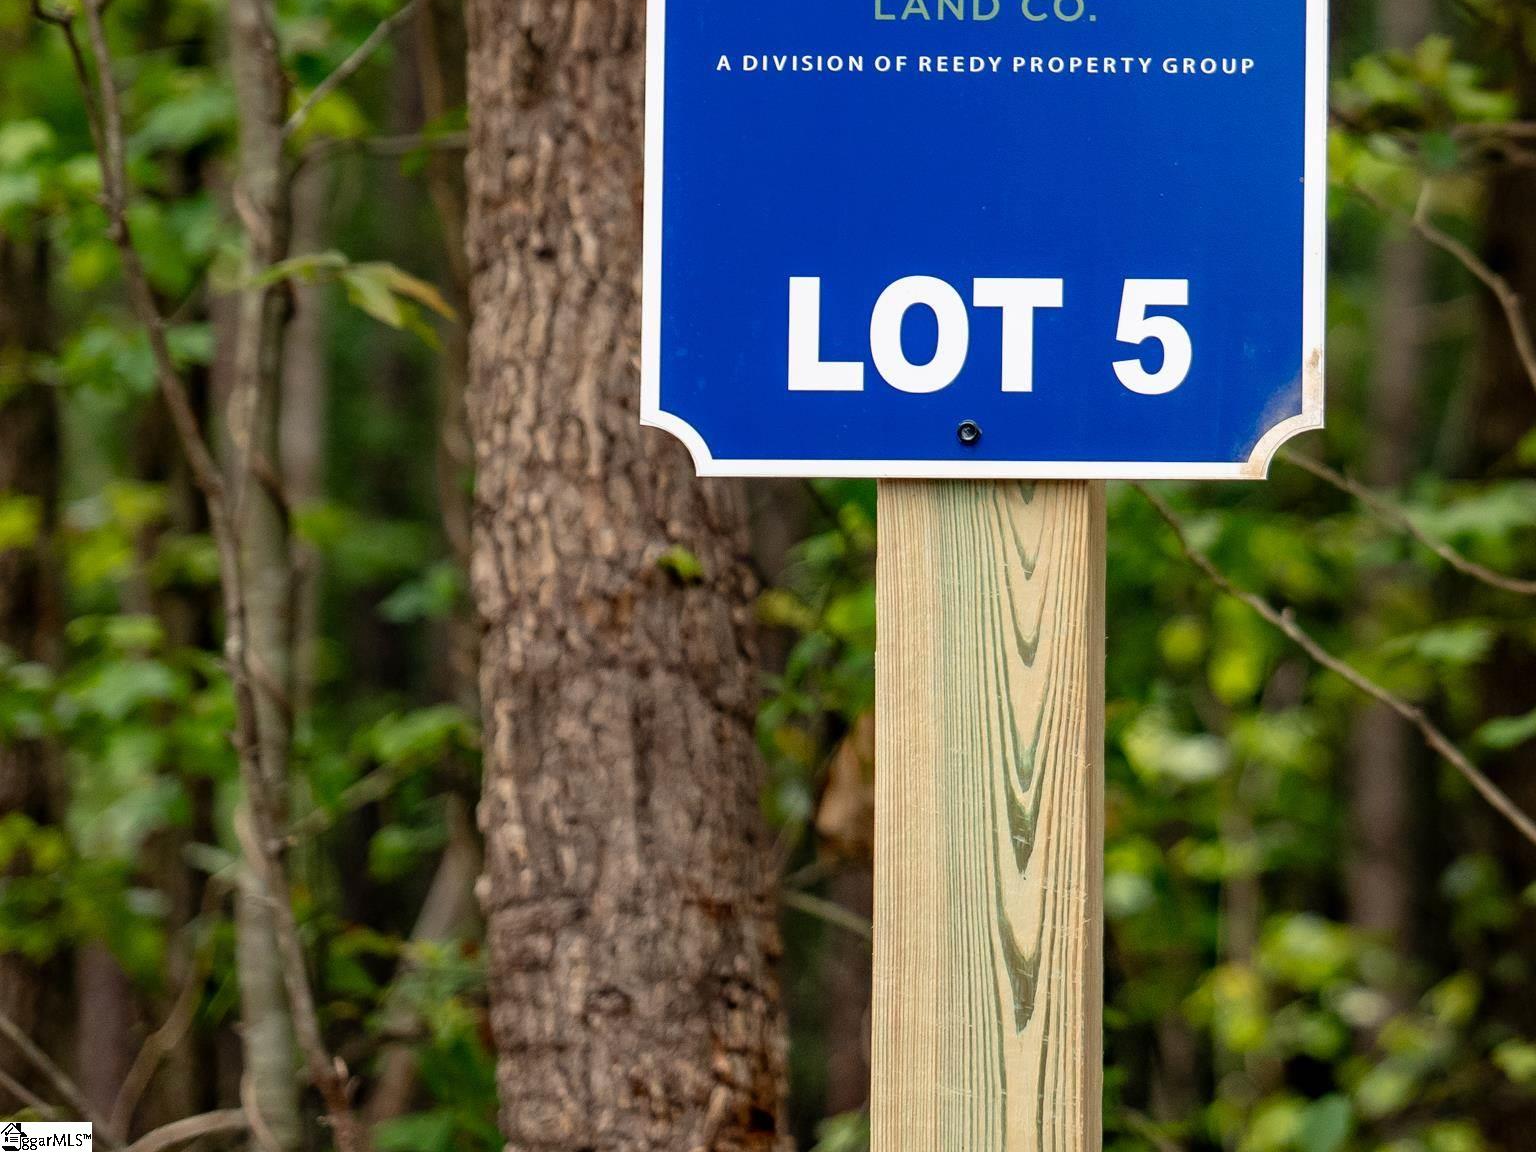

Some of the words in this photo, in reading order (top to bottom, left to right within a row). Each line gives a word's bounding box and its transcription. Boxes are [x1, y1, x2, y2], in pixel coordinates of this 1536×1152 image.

[716, 54, 732, 71] A
[742, 54, 863, 72] DIVISION
[874, 55, 908, 72] OF
[918, 55, 1003, 73] REEDY
[1012, 56, 1153, 74] PROPERTY
[1162, 57, 1256, 75] GROUP
[787, 275, 1064, 394] LOT
[1112, 278, 1193, 395] 5
